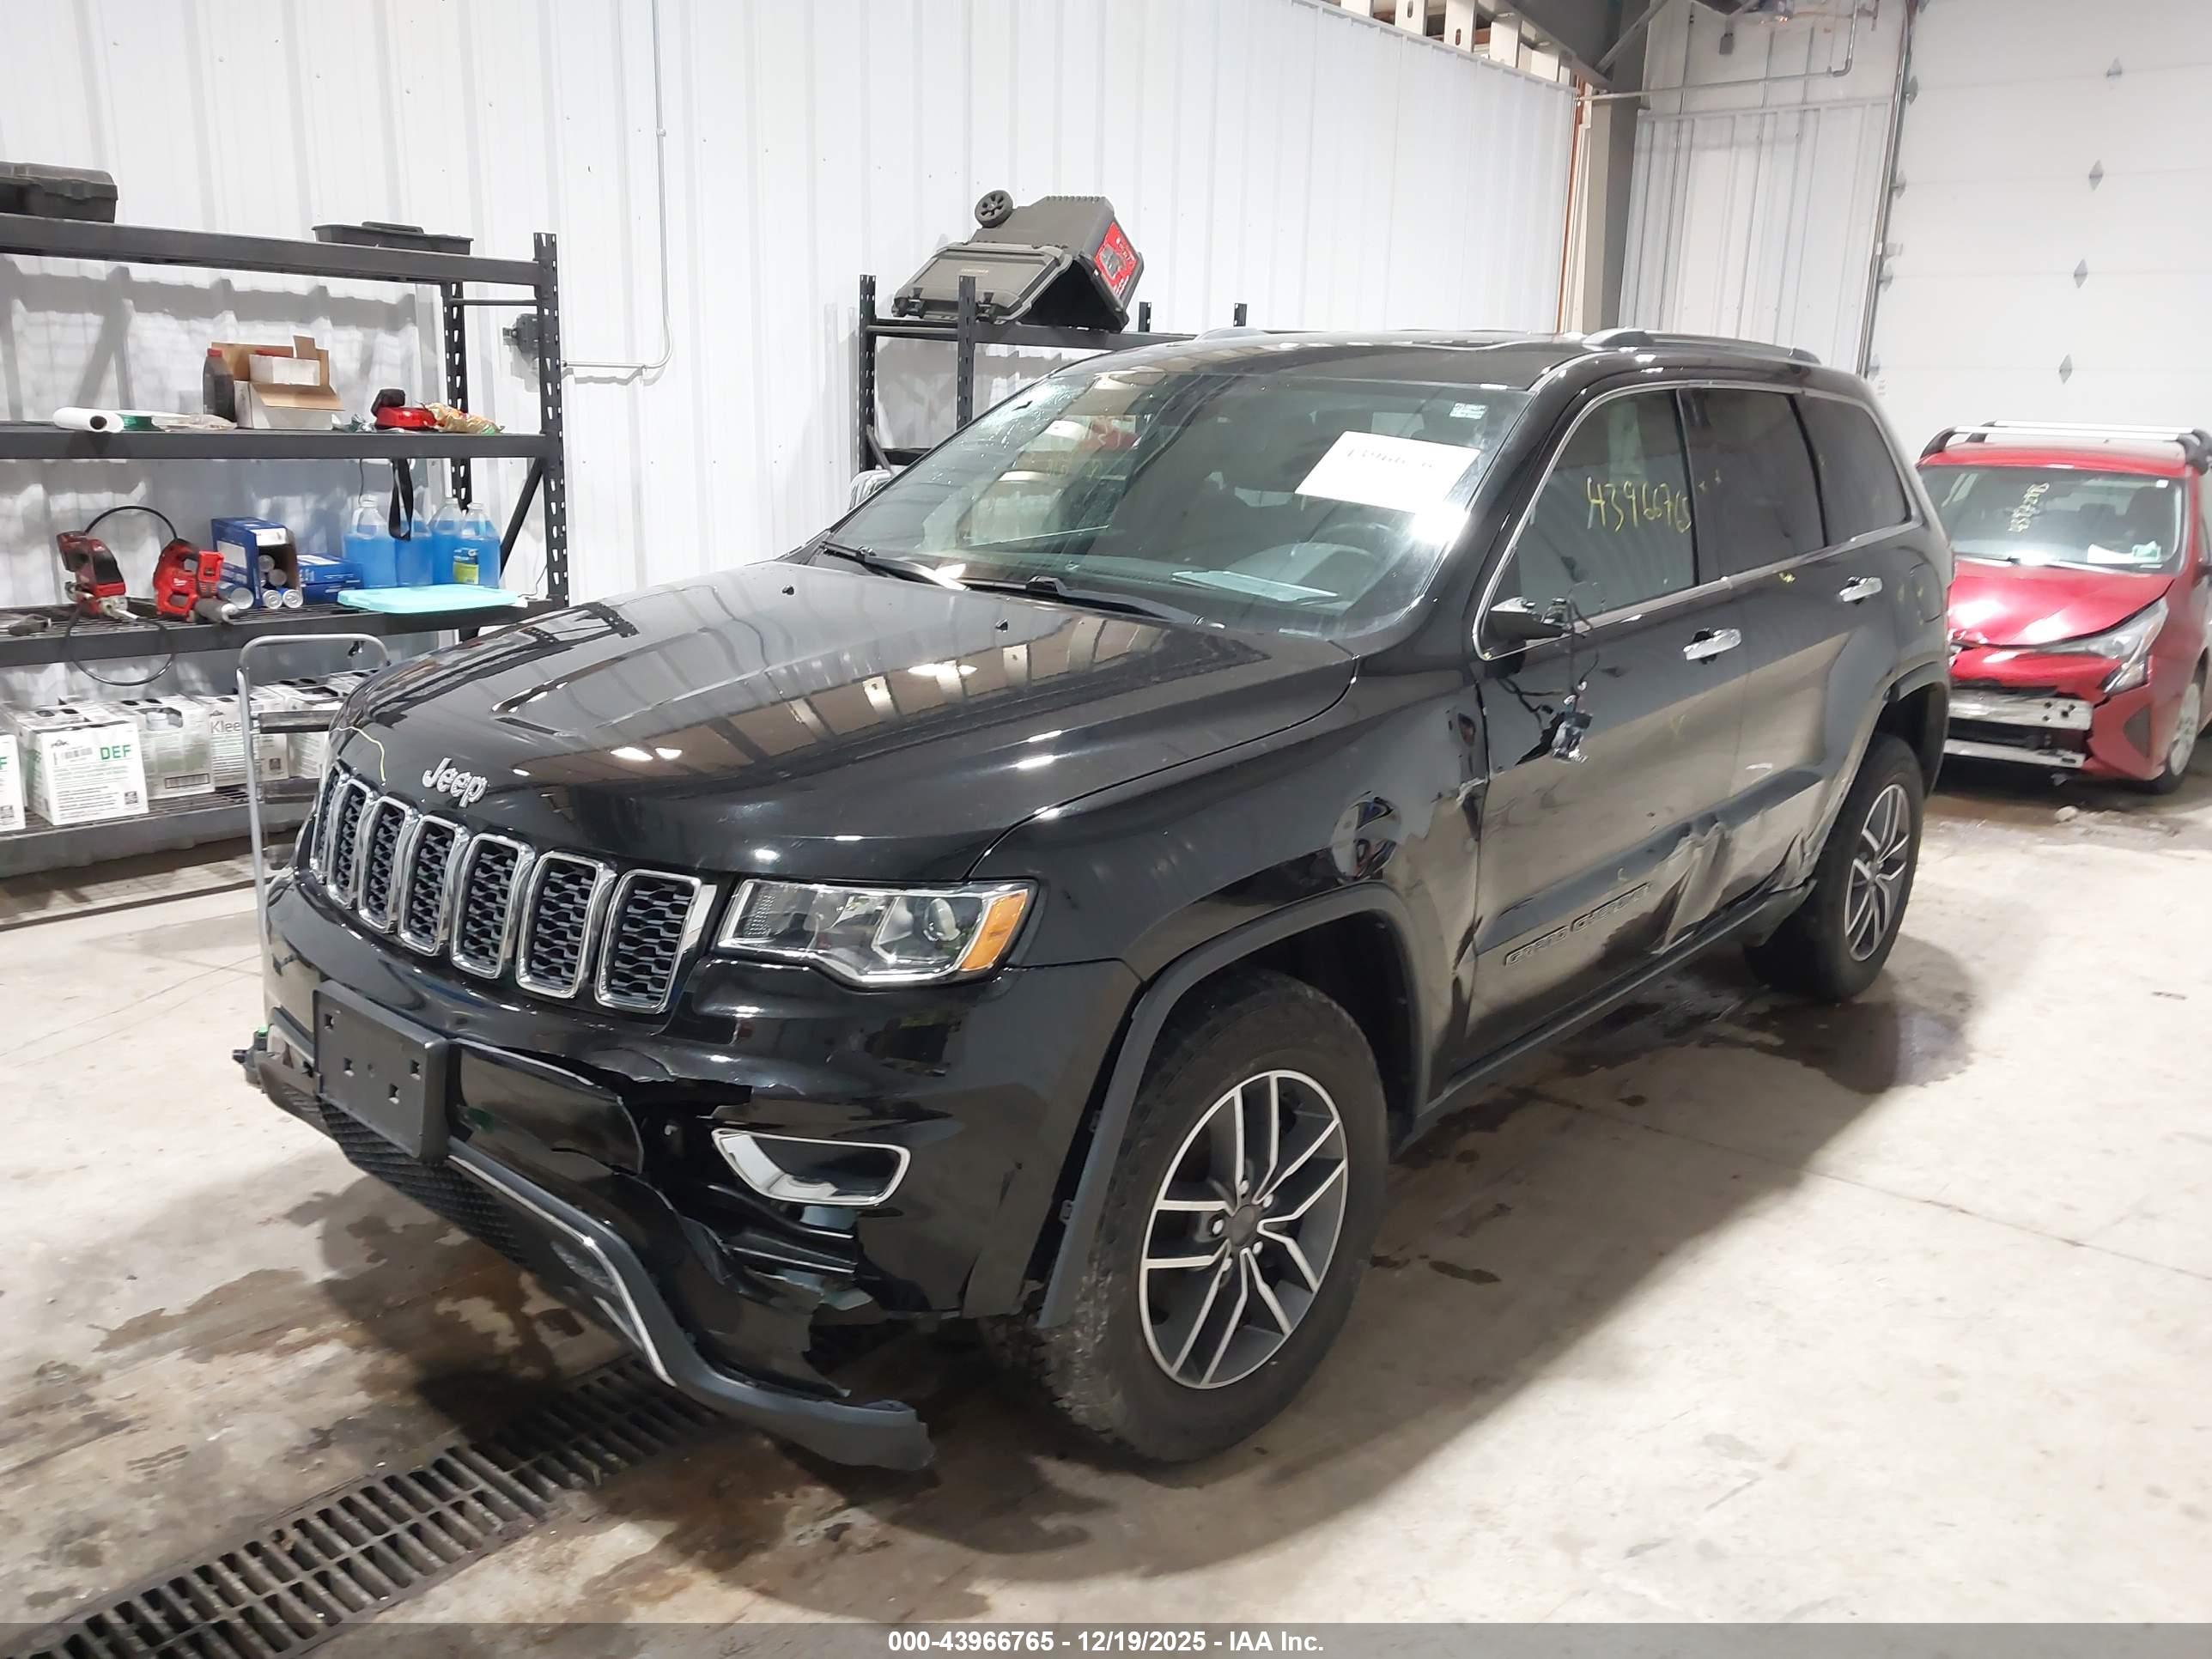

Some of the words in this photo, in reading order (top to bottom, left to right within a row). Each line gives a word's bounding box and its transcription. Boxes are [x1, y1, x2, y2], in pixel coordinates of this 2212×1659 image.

[210, 720, 242, 732] Klee
[100, 744, 131, 760] DEF
[422, 757, 488, 808] Jeep
